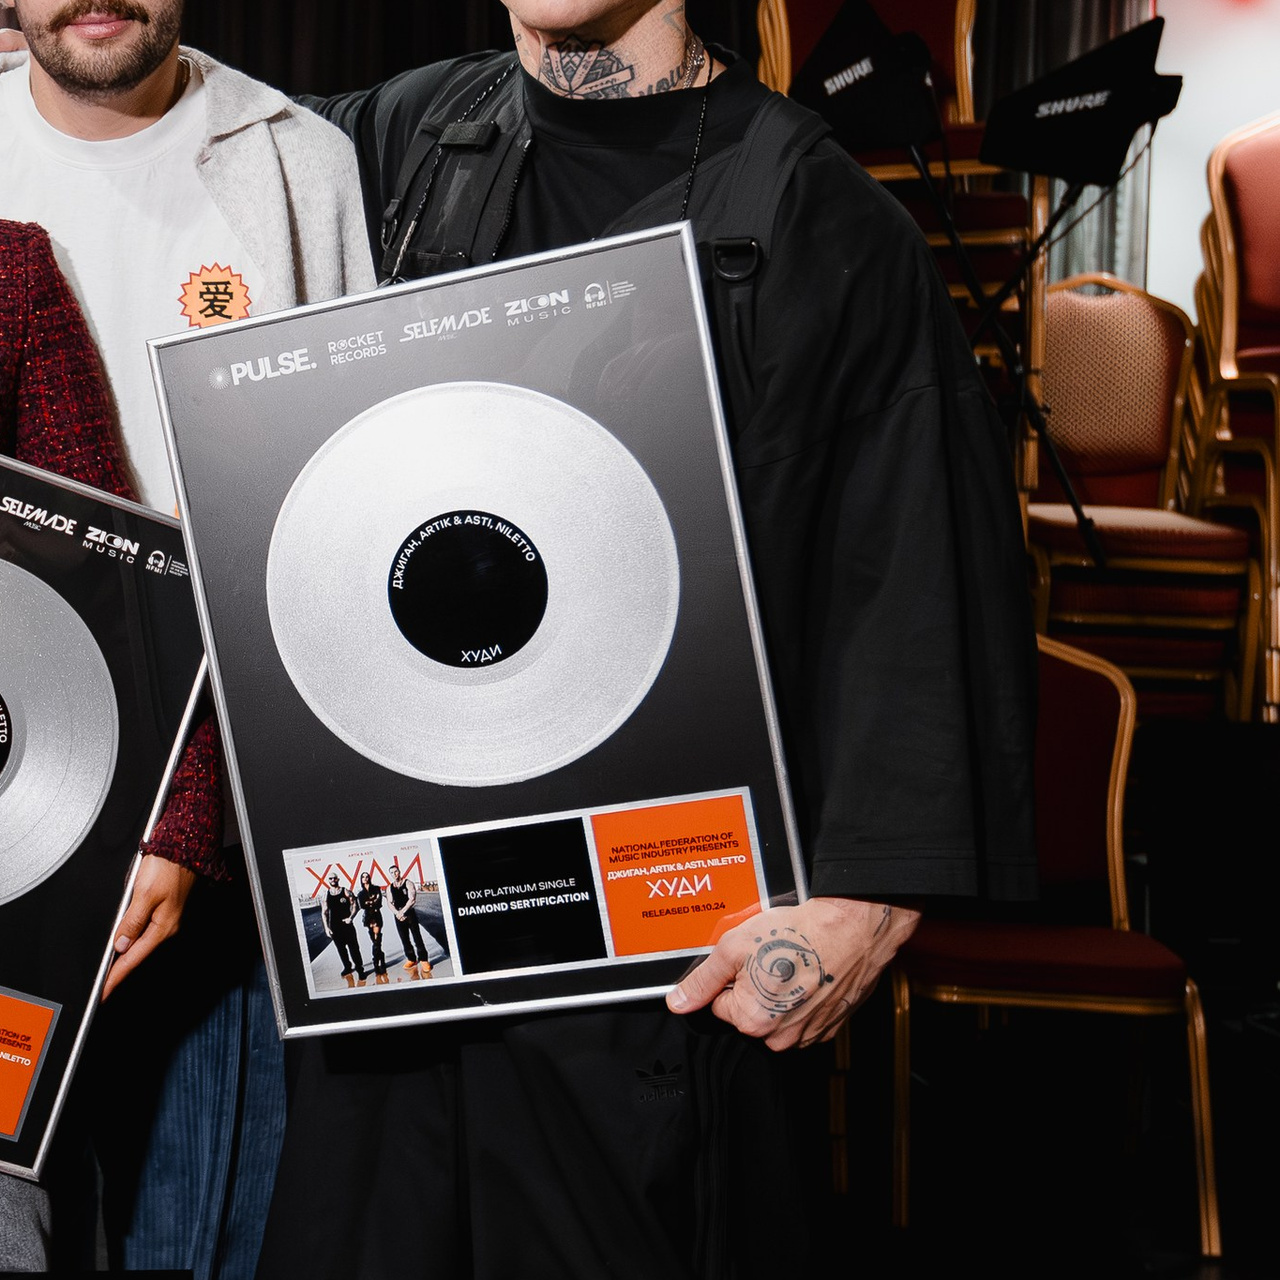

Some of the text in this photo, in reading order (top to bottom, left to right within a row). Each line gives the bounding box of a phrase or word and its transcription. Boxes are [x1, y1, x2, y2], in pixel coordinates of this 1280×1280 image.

[823, 56, 873, 95] SHURE
[1035, 90, 1111, 118] SHURE
[199, 280, 234, 320] 爱
[504, 289, 570, 317] ZION
[399, 307, 492, 343] SELFMADE
[507, 306, 572, 327] MUSIC
[329, 344, 387, 366] RECORDS
[82, 540, 136, 565] MUSIC
[85, 525, 140, 556] ZION
[392, 515, 536, 590] ДЖИГАН, ARTIK & ASTI, NILETTO
[460, 643, 503, 663] ХУДИ
[608, 840, 739, 864] MUSIC INDUSTRY PRESENTS
[611, 831, 734, 855] NATIONAL FEDERATION OF
[607, 854, 747, 881] ДЖИГАН, ARTIK & ASTI, NILETTO
[465, 877, 576, 900] 10X PLATINUM SINGLE
[645, 873, 712, 899] ХУДИ
[457, 891, 590, 917] DIAMOND SERTIFICATION
[642, 901, 726, 919] RELEASED 18.10.24
[20, 1034, 32, 1043] OF
[0, 1051, 32, 1066] NILETTO
